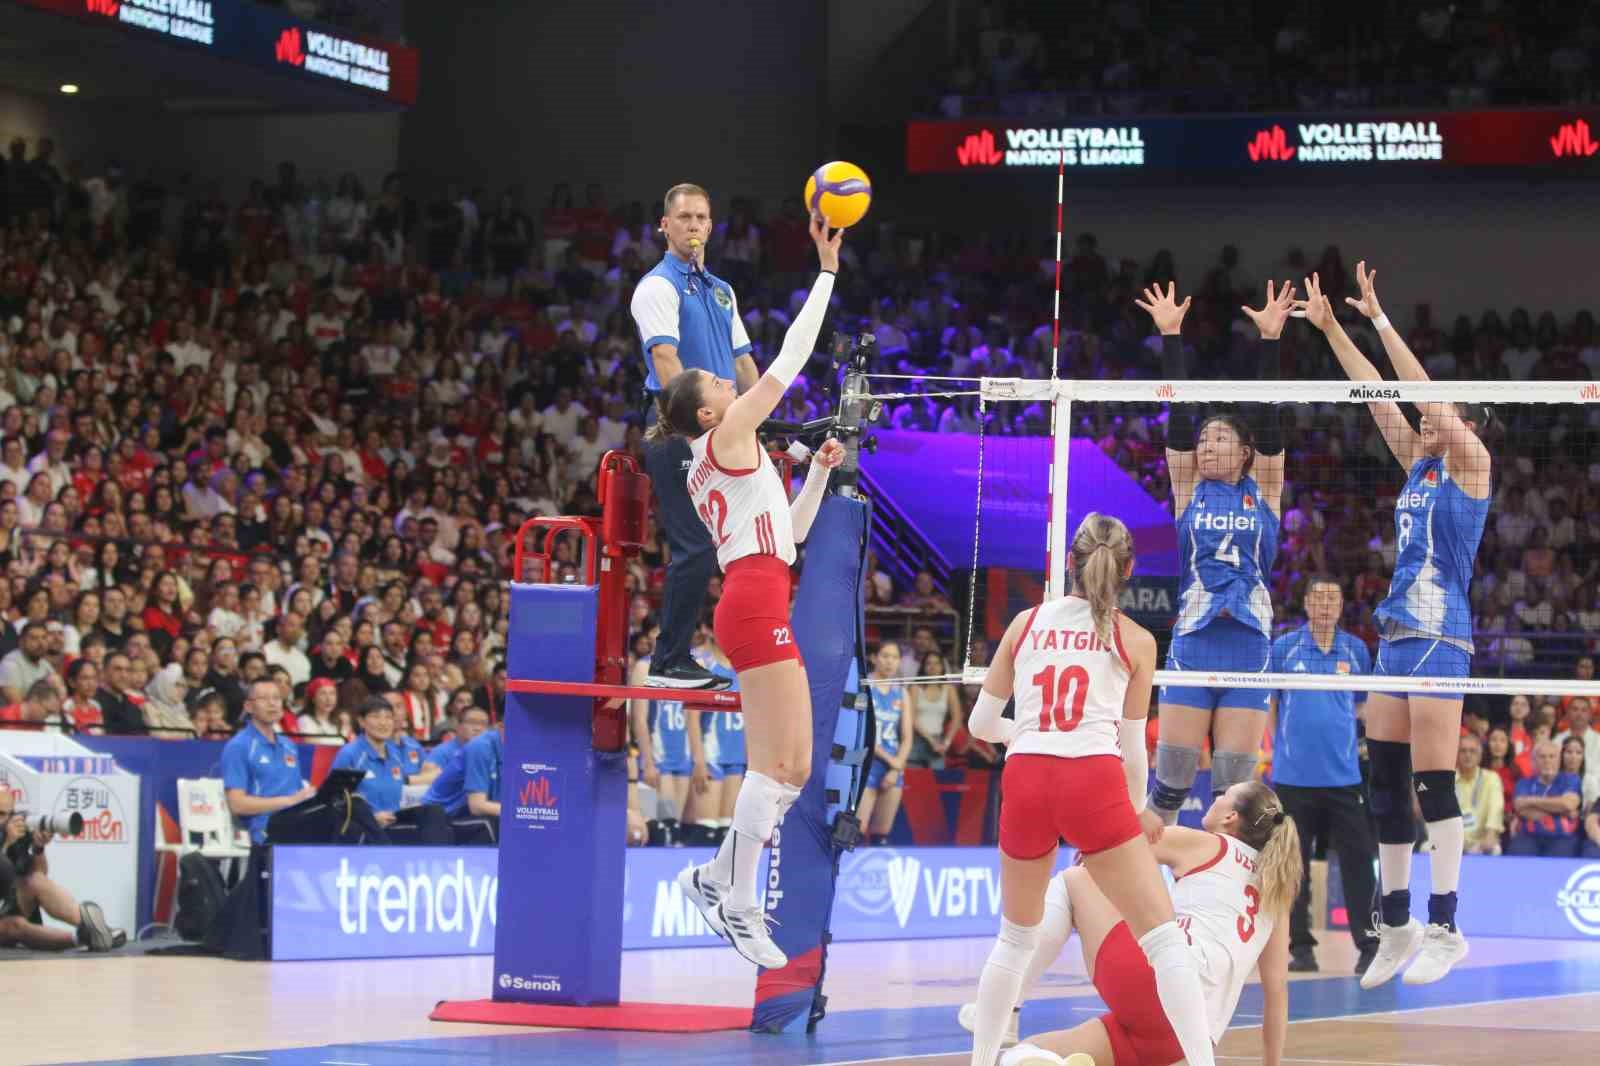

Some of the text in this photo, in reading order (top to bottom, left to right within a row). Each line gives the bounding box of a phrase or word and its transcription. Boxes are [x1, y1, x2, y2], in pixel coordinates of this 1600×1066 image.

[306, 31, 390, 73] VOLLEYBALL
[1005, 128, 1144, 148] VOLLEYBALL
[1298, 122, 1442, 144] VOLLEYBALL
[1005, 149, 1144, 165] NATIONS LEAGUE
[1298, 143, 1443, 161] NATIONS LEAGUE
[1396, 488, 1430, 510] aier
[1194, 511, 1255, 531] Haier
[1398, 512, 1413, 555] 8
[1215, 532, 1240, 569] 4
[1119, 587, 1171, 612] ARA
[773, 627, 792, 646] 22
[1033, 664, 1090, 732] 10
[663, 703, 685, 731] 16
[65, 788, 109, 809] 百岁山
[766, 815, 784, 911] enoh
[923, 867, 1001, 917] VBTV
[1236, 884, 1260, 943] 3
[512, 976, 561, 992] Senoh
